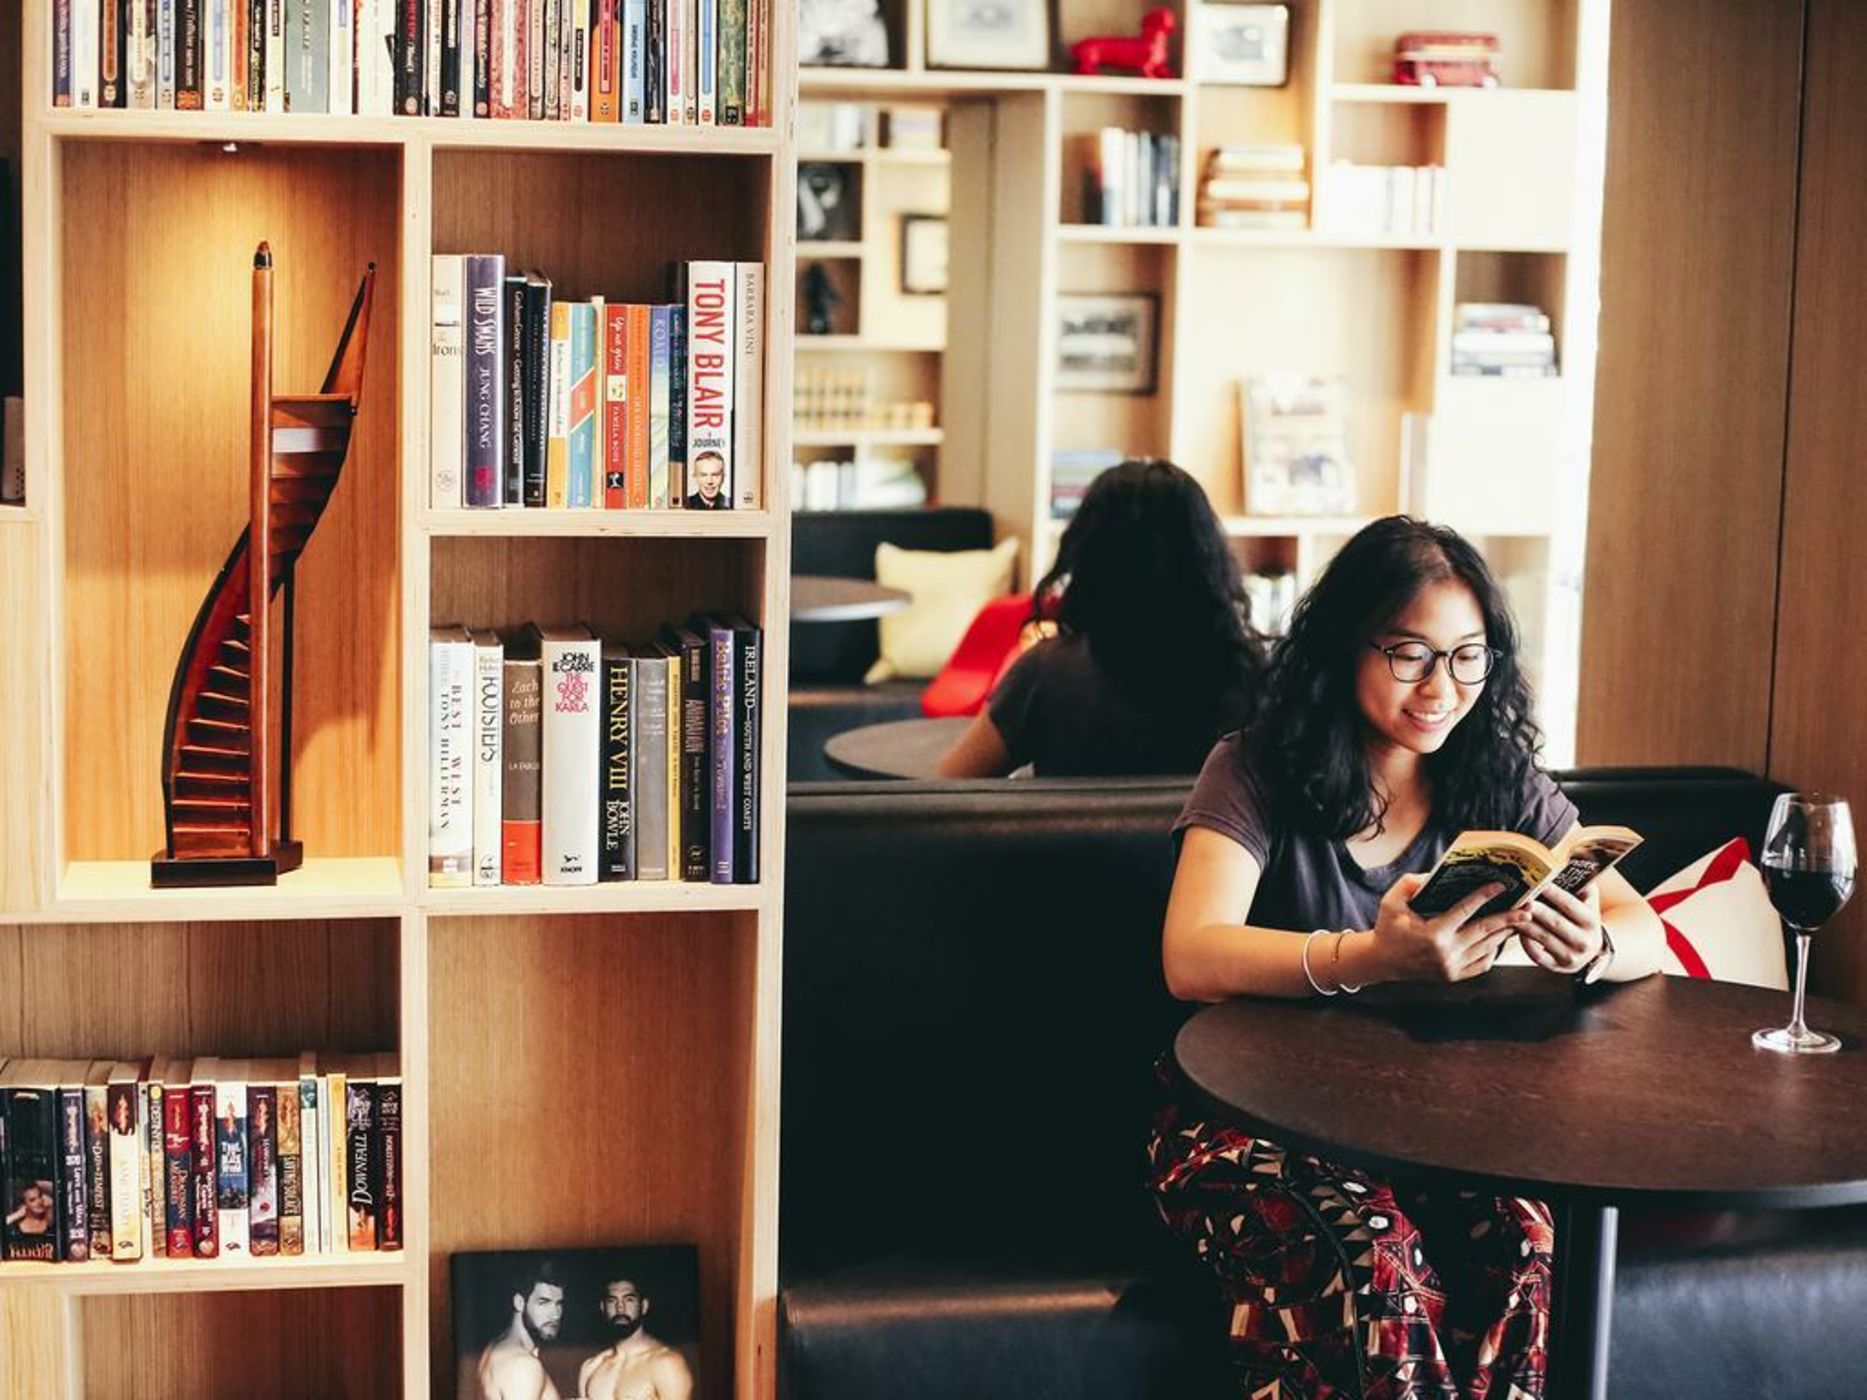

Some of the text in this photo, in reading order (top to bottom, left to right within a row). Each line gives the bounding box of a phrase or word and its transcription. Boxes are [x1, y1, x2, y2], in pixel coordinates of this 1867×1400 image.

[474, 286, 497, 355] WILD SWANS
[513, 290, 524, 351] Graham Greene
[744, 272, 755, 324] BARBARA
[694, 277, 726, 428] TONY BLAIR
[478, 365, 491, 450] JUNG CHANG
[560, 652, 589, 662] JOHN
[715, 639, 732, 691] Baltic
[440, 693, 450, 732] TONY
[480, 676, 500, 763] FOOTSTEPS
[555, 702, 590, 712] KARLA
[608, 665, 628, 790] HENRY VIII
[685, 699, 705, 753] ANIMATION
[715, 693, 732, 736] Pilot
[450, 684, 462, 806] BEST WEST
[743, 752, 752, 772] AND
[440, 737, 450, 830] HILLERMAN
[743, 773, 752, 797] WEST
[606, 800, 620, 851] BOWLE
[618, 799, 631, 837] JOHN
[351, 1133, 374, 1205] DOWNFALL
